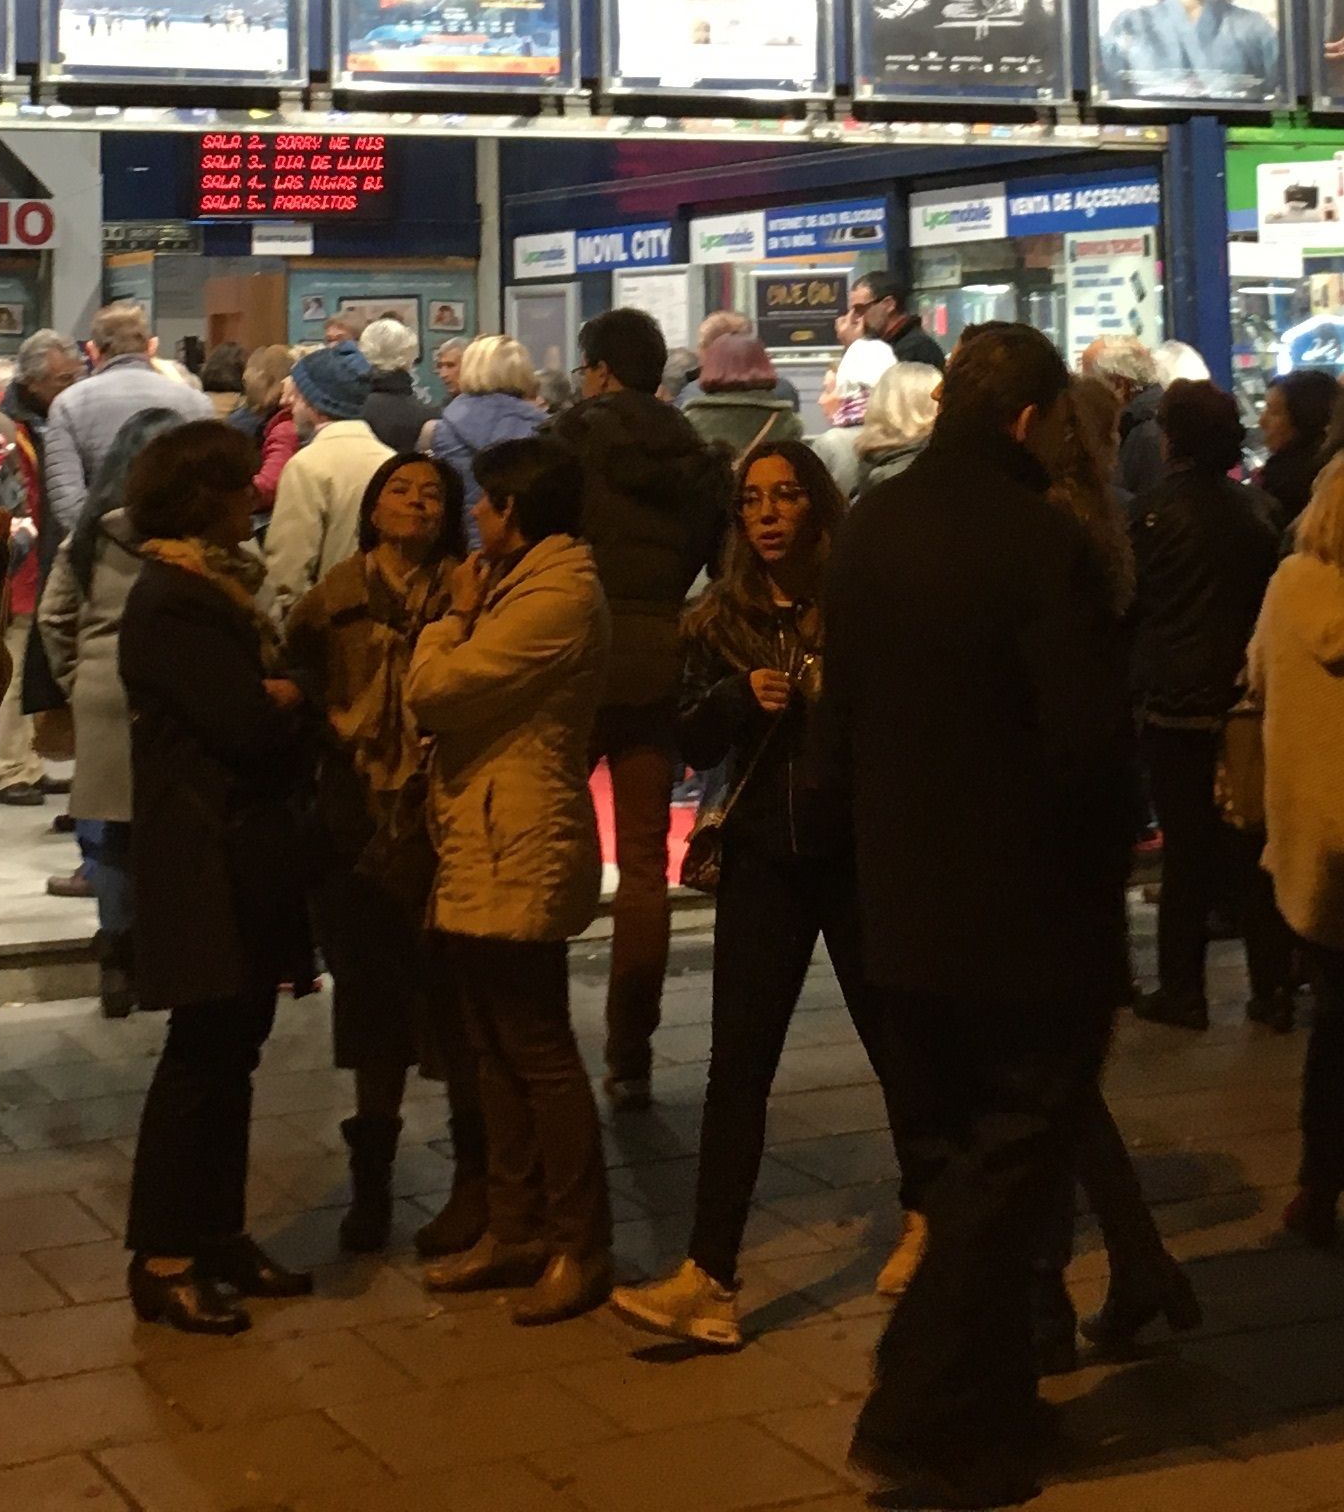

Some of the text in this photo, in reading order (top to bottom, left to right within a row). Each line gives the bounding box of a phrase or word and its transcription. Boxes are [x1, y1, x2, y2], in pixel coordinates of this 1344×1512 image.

[202, 135, 242, 149] SALA
[329, 136, 351, 150] WE
[355, 137, 385, 150] MIS
[202, 155, 242, 169] SALA
[310, 155, 332, 170] DE
[201, 175, 242, 189] SALA
[274, 175, 304, 190] LAS
[201, 195, 242, 210] SALA
[273, 195, 358, 210] PARASITOS
[1009, 193, 1049, 216] VENTA
[1053, 192, 1072, 212] DE
[1075, 183, 1160, 210] ACCESORIOS
[577, 235, 627, 265] MOVIL
[631, 227, 672, 261] CITY
